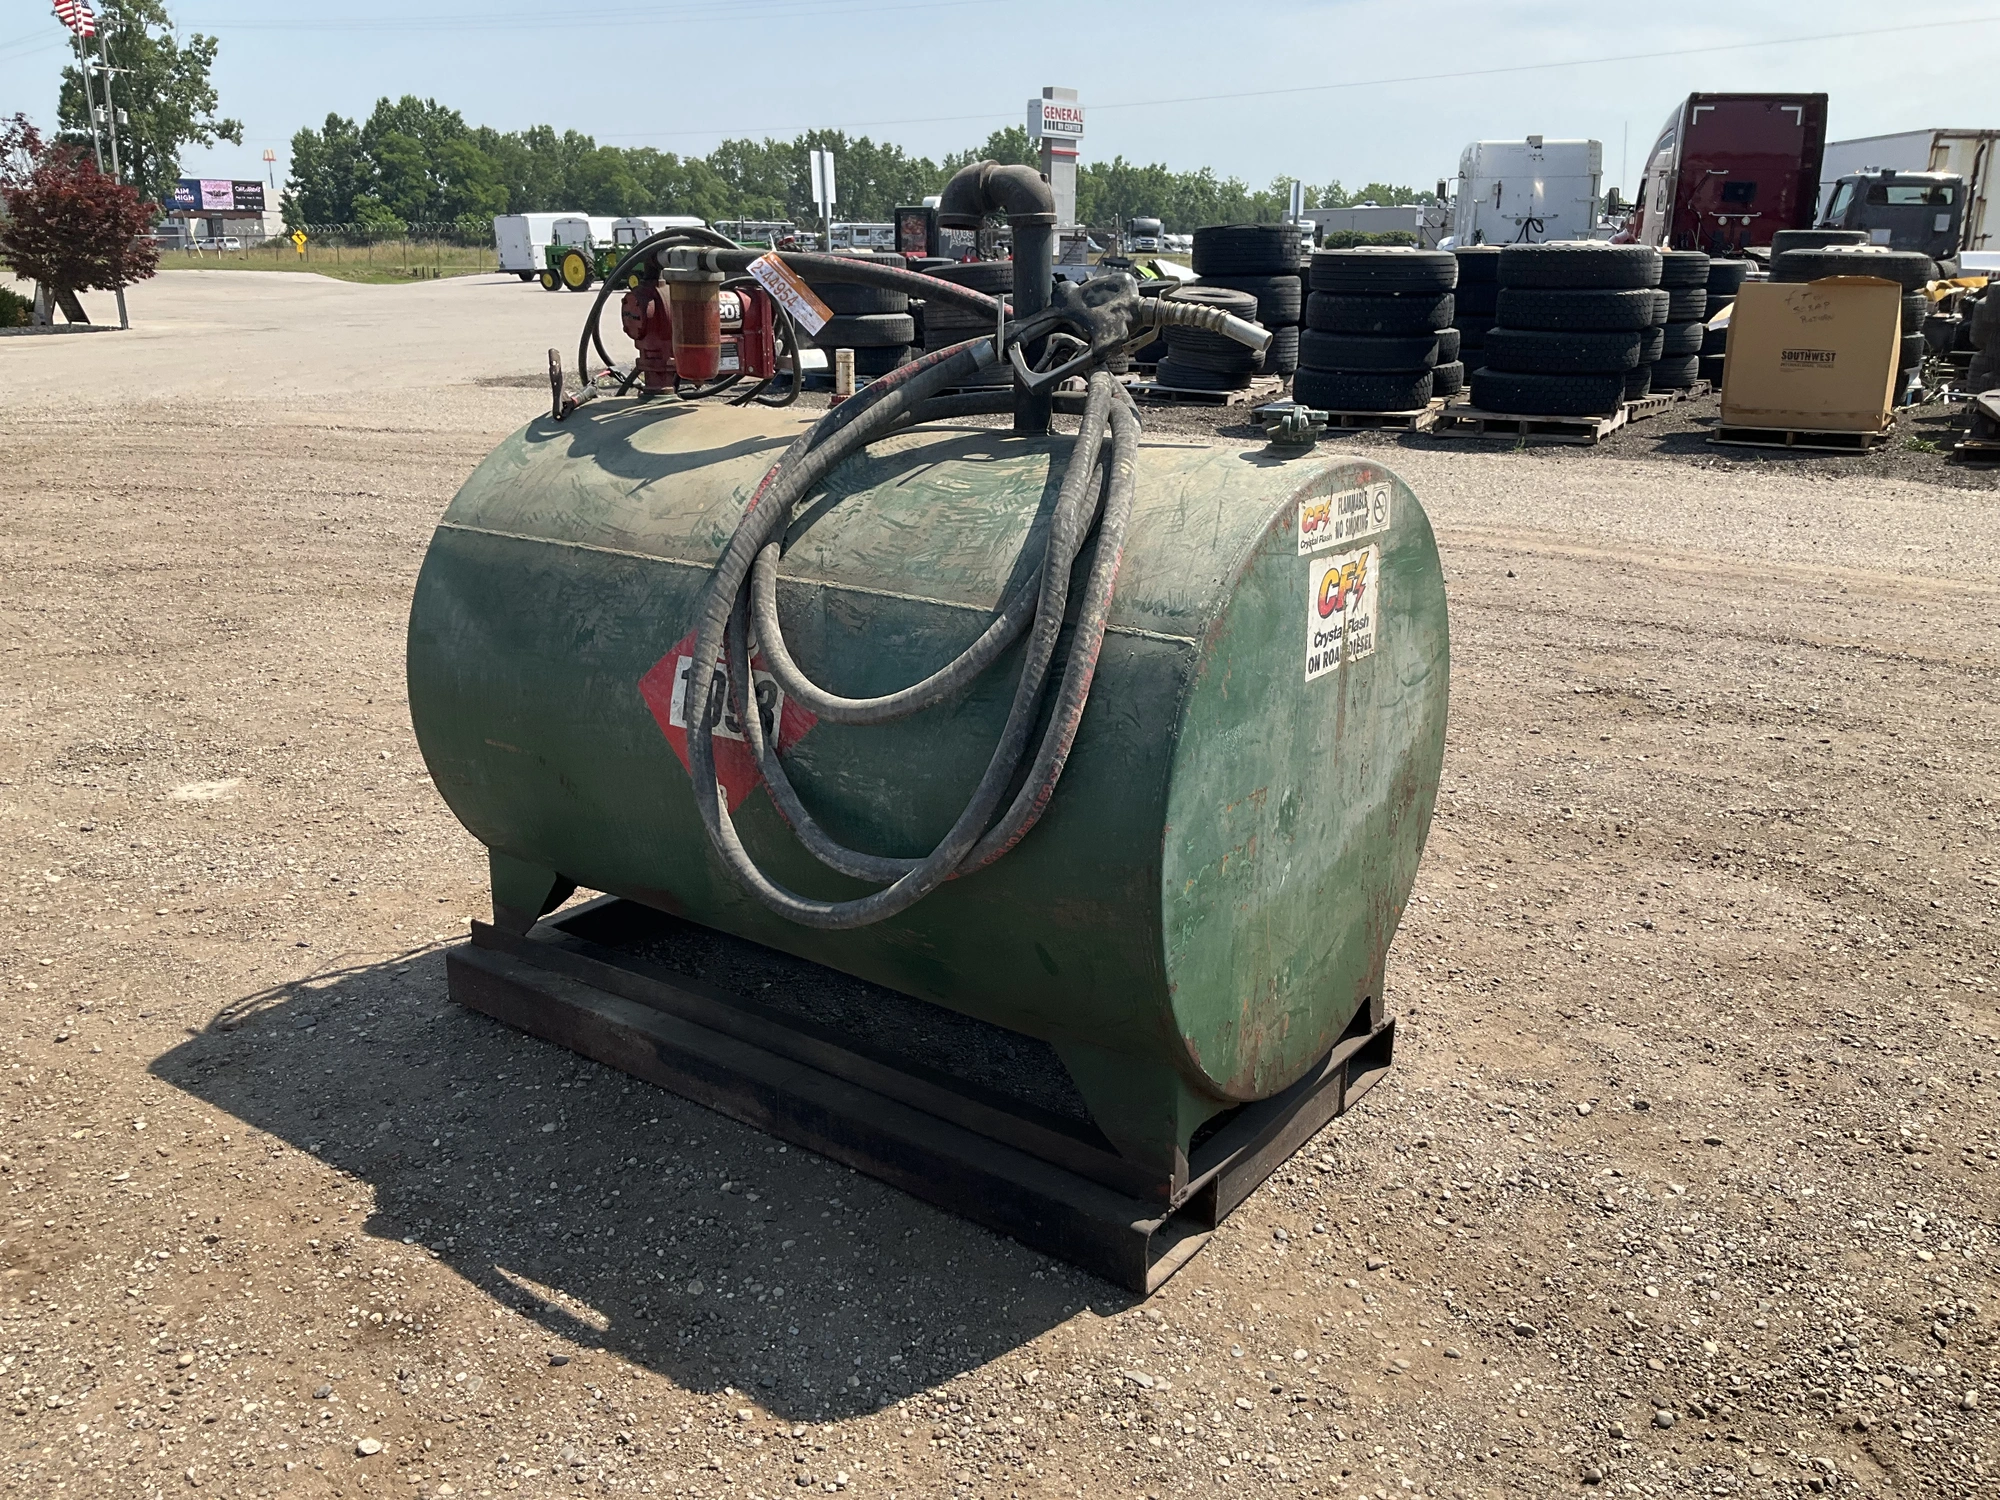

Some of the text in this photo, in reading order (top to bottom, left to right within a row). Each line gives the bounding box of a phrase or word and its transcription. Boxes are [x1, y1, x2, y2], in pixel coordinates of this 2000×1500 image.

[1044, 106, 1083, 122] GENERAL
[750, 261, 799, 308] 2-44954
[1781, 350, 1836, 362] SOUTHWEST
[1337, 490, 1368, 515] FLAMMABLE
[1335, 513, 1369, 539] NO SMOKING
[1300, 533, 1332, 550] Crystal Flash
[1314, 613, 1370, 648] Crysta Flash
[1308, 653, 1320, 674] ON
[1323, 646, 1341, 668] ROA
[1016, 815, 1036, 836] bar
